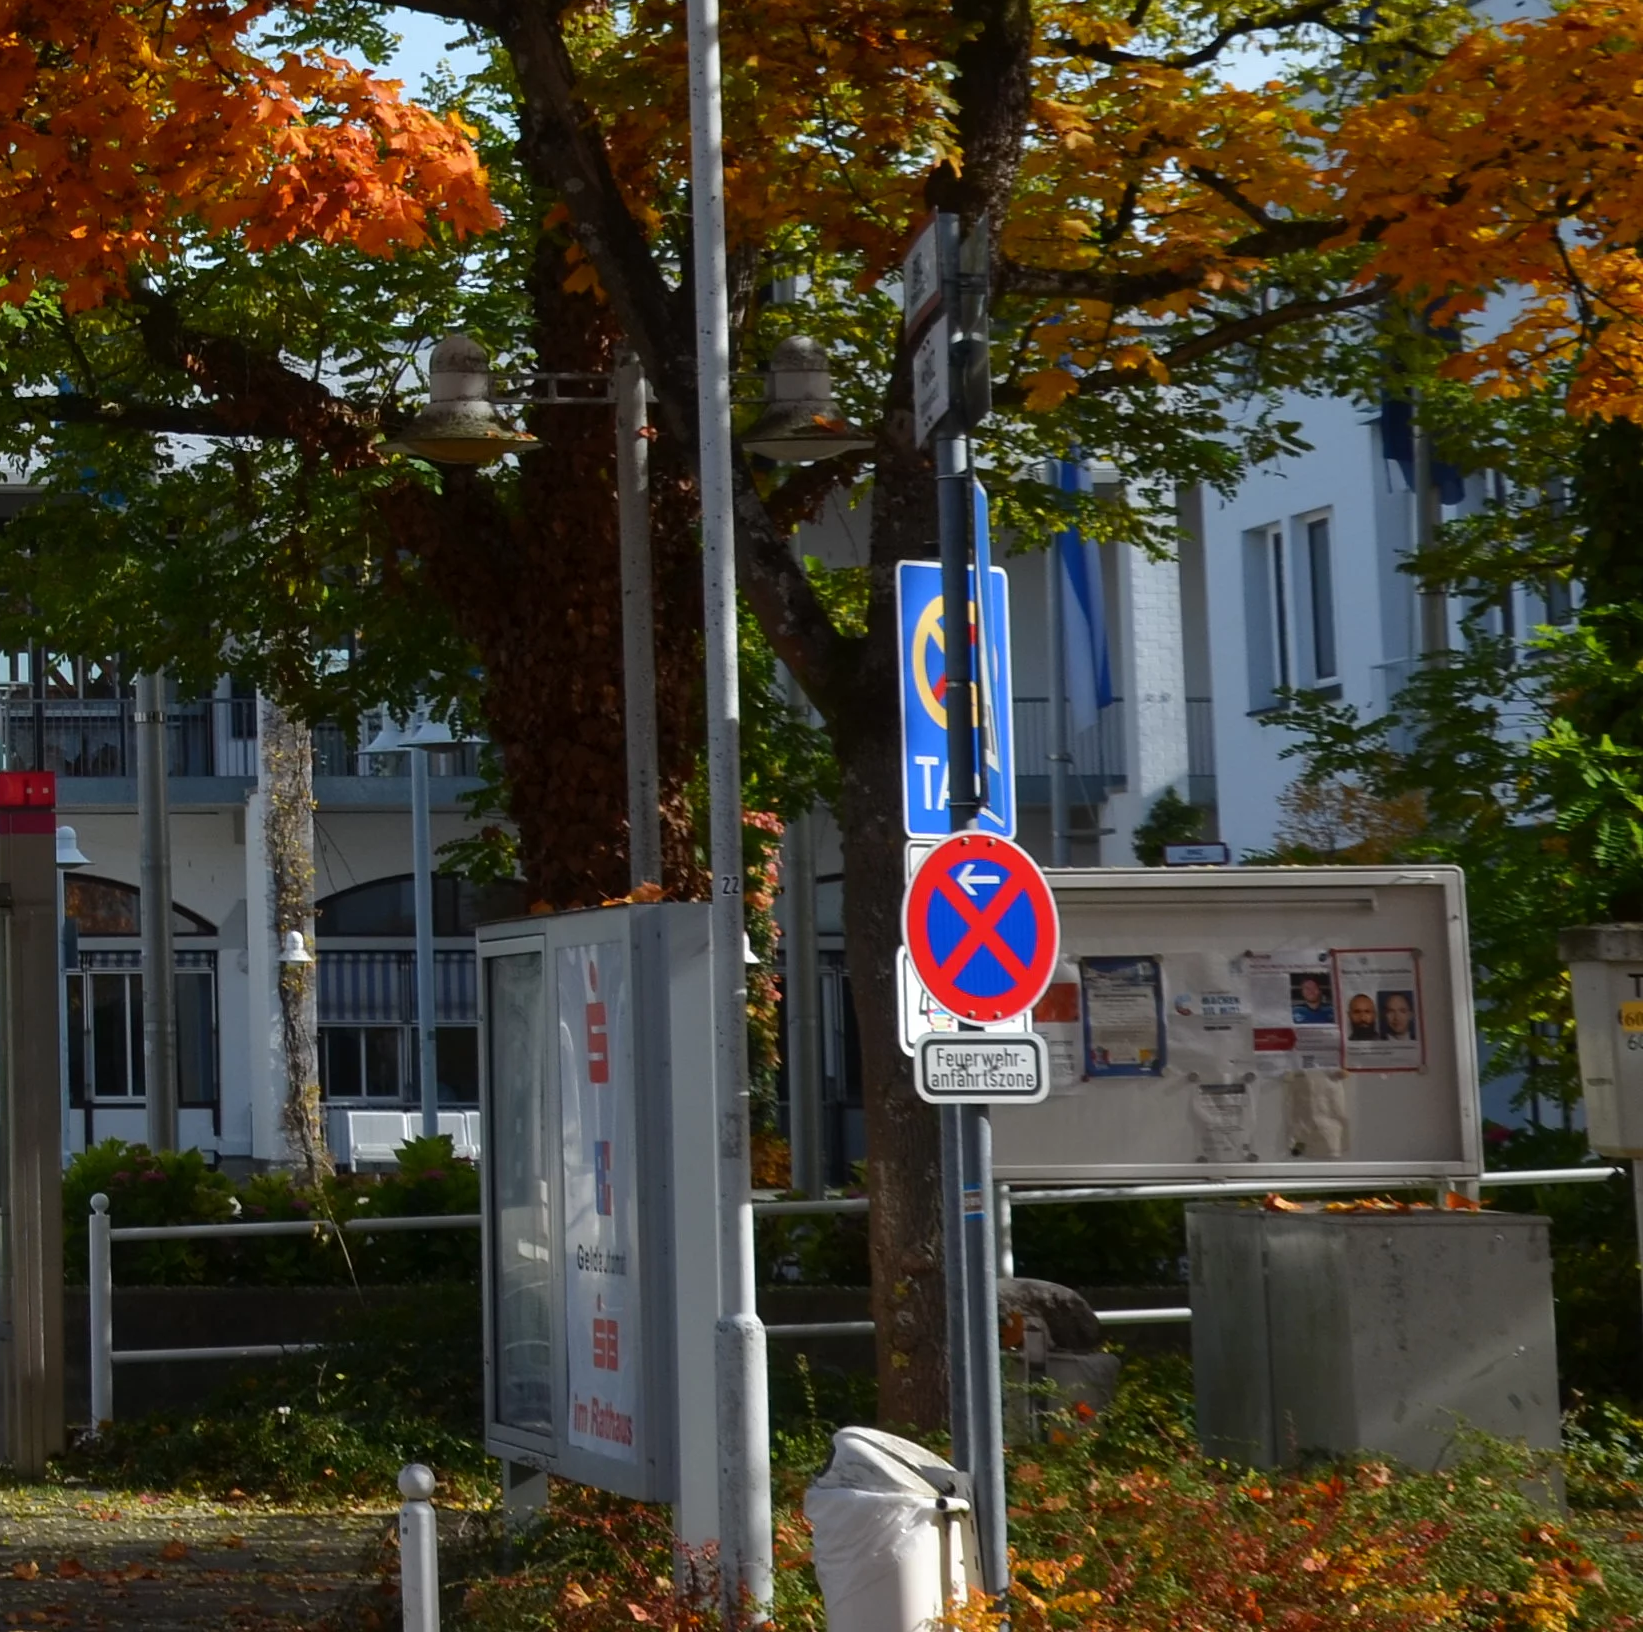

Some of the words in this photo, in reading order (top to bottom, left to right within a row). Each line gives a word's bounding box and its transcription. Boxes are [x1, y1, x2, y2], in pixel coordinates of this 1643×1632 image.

[722, 876, 740, 895] 22
[936, 1047, 1028, 1067] Feuerwehr-
[931, 1068, 1035, 1088] anfahrtszone
[573, 1392, 588, 1433] im
[590, 1395, 633, 1447] Rathaus
